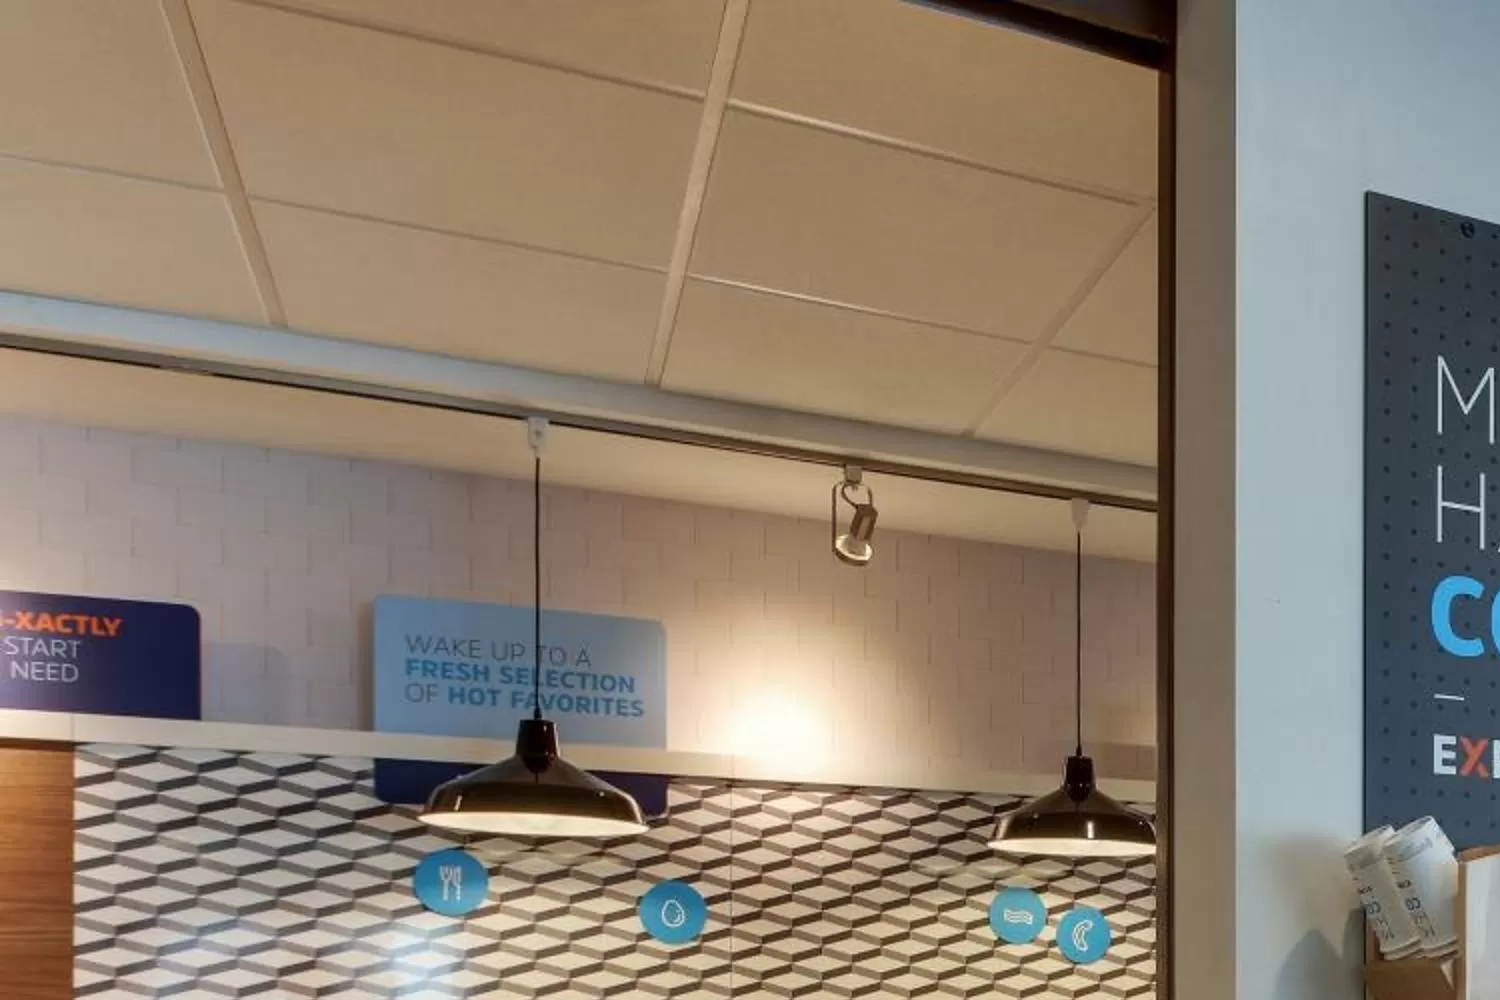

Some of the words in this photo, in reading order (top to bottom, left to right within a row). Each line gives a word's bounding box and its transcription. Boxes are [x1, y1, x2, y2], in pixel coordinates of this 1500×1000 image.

[0, 607, 124, 637] -XACTLY
[3, 635, 81, 659] START
[404, 632, 482, 660] WAKE
[490, 639, 527, 663] UP
[575, 647, 593, 668] A
[9, 660, 80, 684] NEED
[404, 657, 490, 683] FRESH
[499, 665, 636, 694] SELECTION
[403, 682, 440, 704] OF
[447, 684, 502, 708] HOT
[511, 690, 645, 718] FAVORITES
